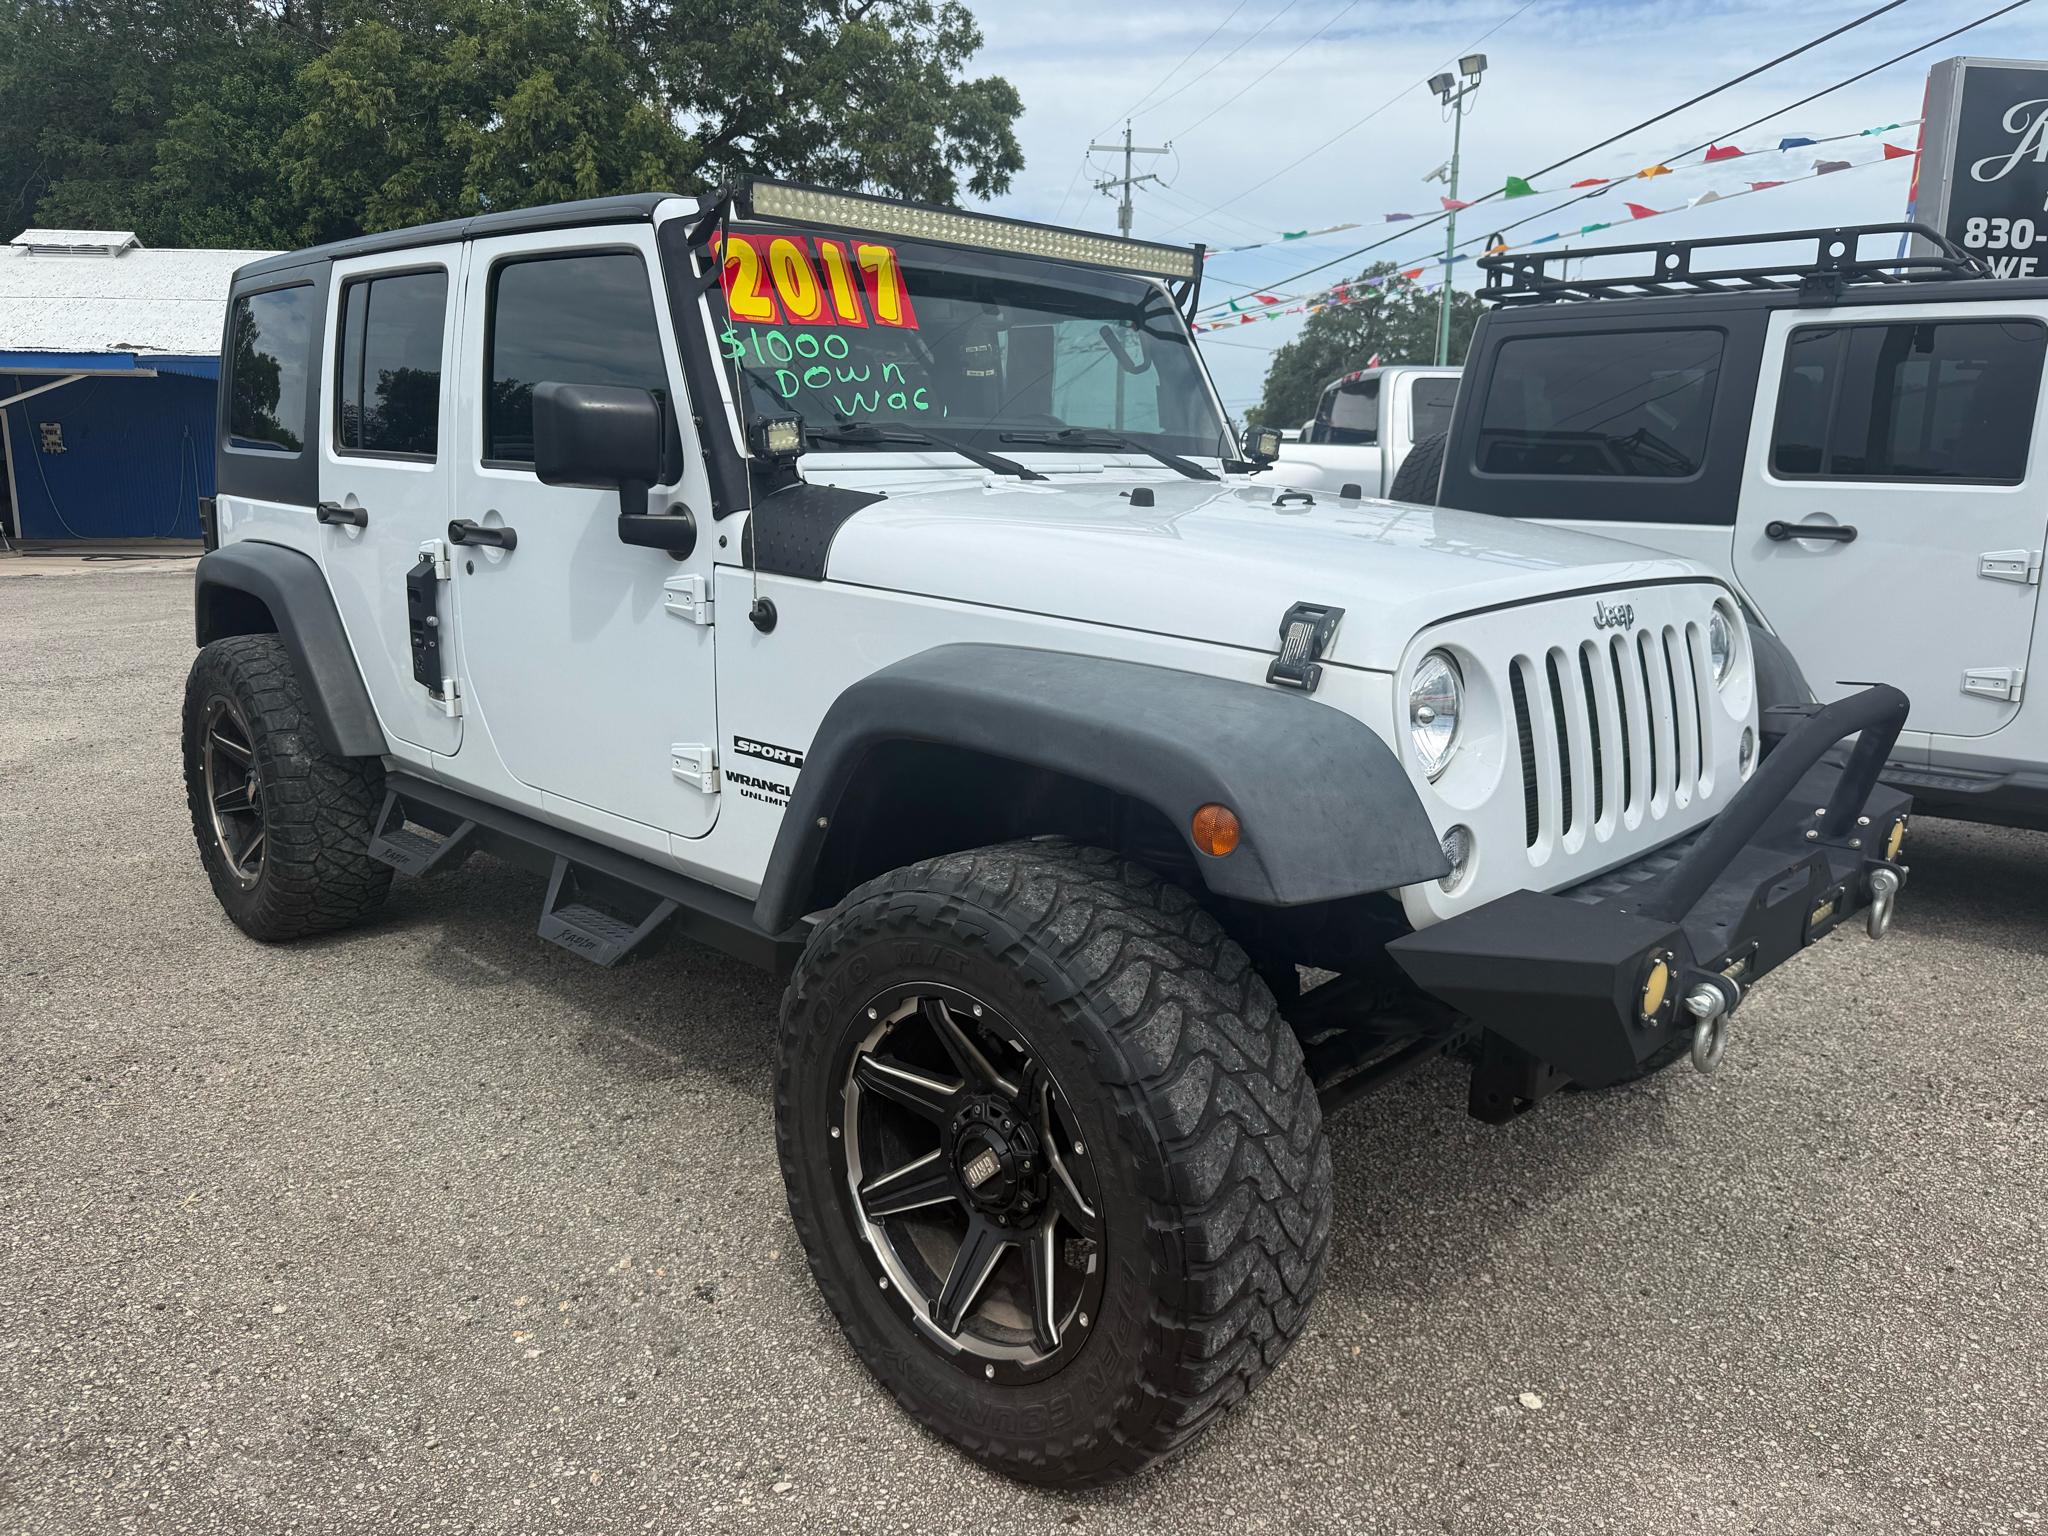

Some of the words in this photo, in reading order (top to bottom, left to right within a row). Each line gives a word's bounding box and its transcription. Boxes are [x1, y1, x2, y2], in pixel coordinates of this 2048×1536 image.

[1963, 217, 2047, 250] 830-
[714, 237, 904, 326] 2017
[720, 316, 849, 372] $1000
[1593, 600, 1635, 631] Jeep
[736, 739, 803, 764] SPORT
